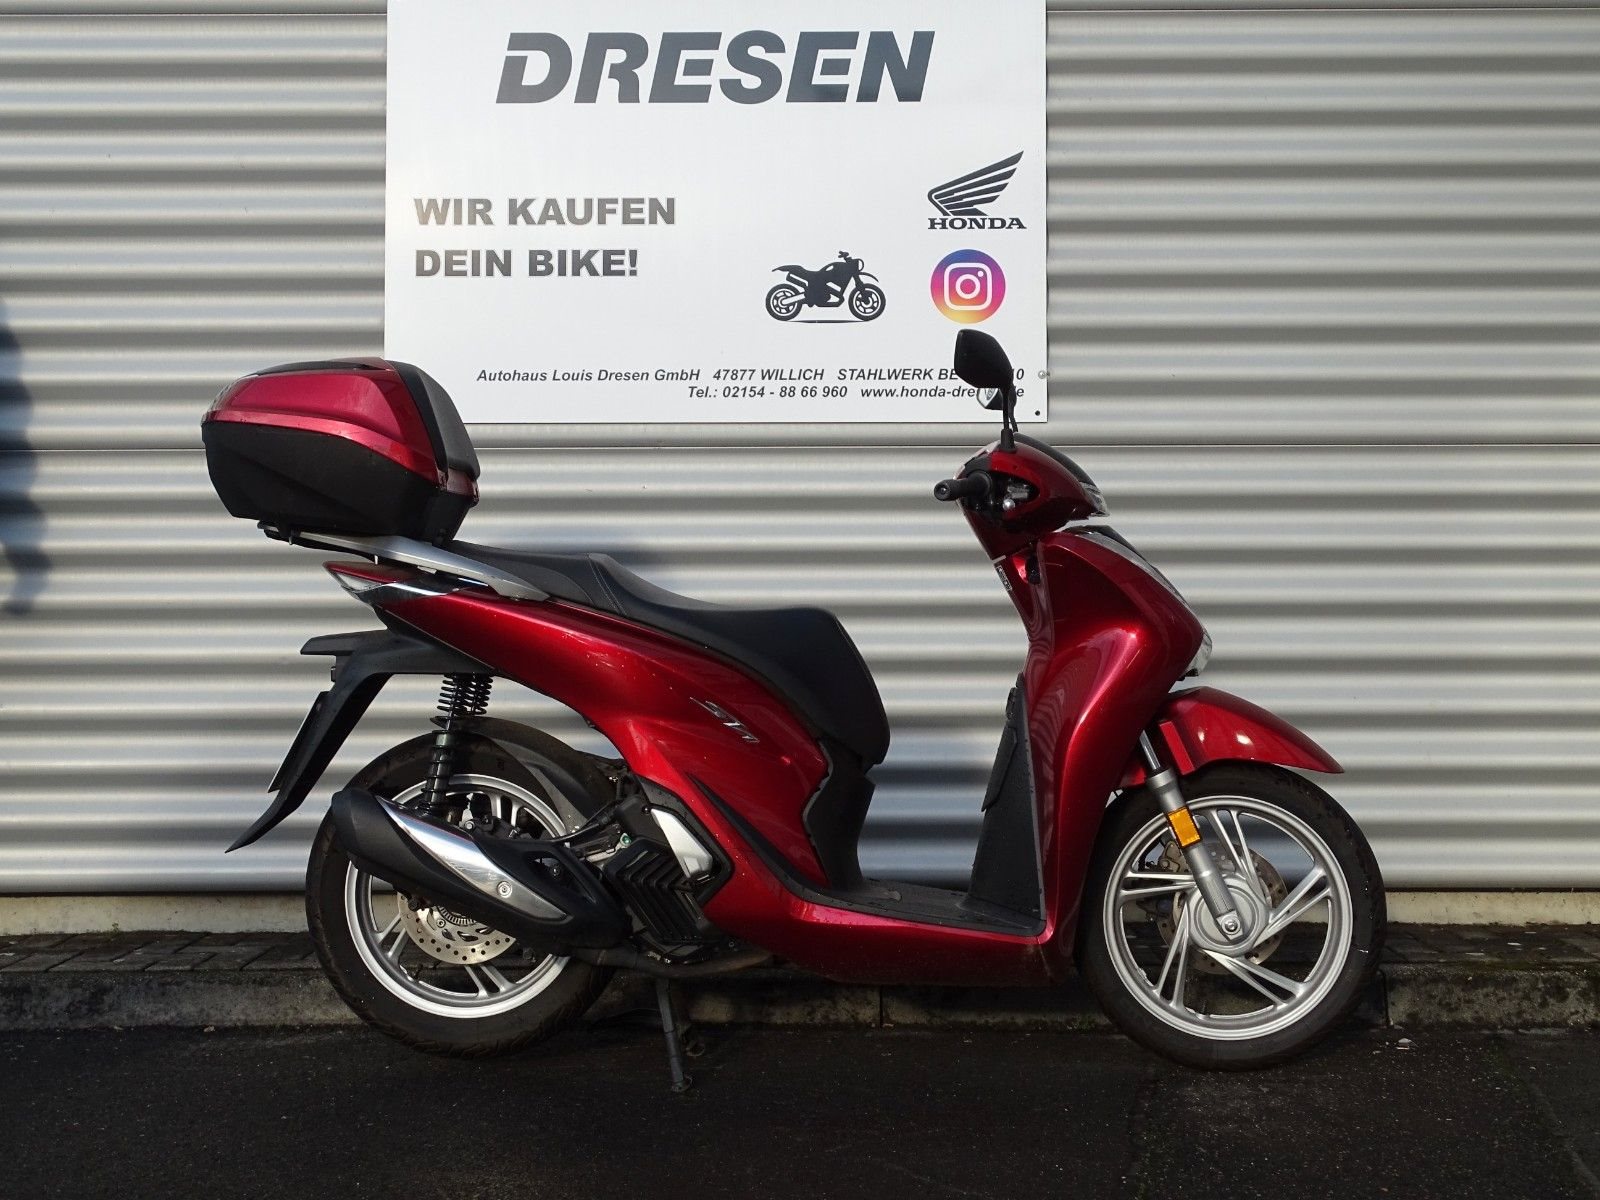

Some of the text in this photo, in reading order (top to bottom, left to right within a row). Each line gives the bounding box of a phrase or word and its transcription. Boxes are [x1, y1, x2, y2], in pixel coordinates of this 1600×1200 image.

[496, 31, 935, 104] DRESEN
[414, 197, 676, 225] WIR KAUFEN
[928, 216, 1026, 230] HONDA
[415, 249, 638, 277] DEIN BIKE!
[476, 368, 548, 382] Autohaus
[553, 368, 593, 382] Louis
[597, 368, 650, 381] Dresen
[654, 368, 701, 381] GmbH
[712, 368, 756, 381] 47877
[761, 368, 825, 381] WILLICH
[837, 368, 934, 381] STAHLWERK
[688, 385, 718, 398] Tel.:
[722, 385, 765, 398] 02154
[779, 385, 797, 398] 88
[800, 385, 818, 398] 66
[822, 385, 848, 398] 960
